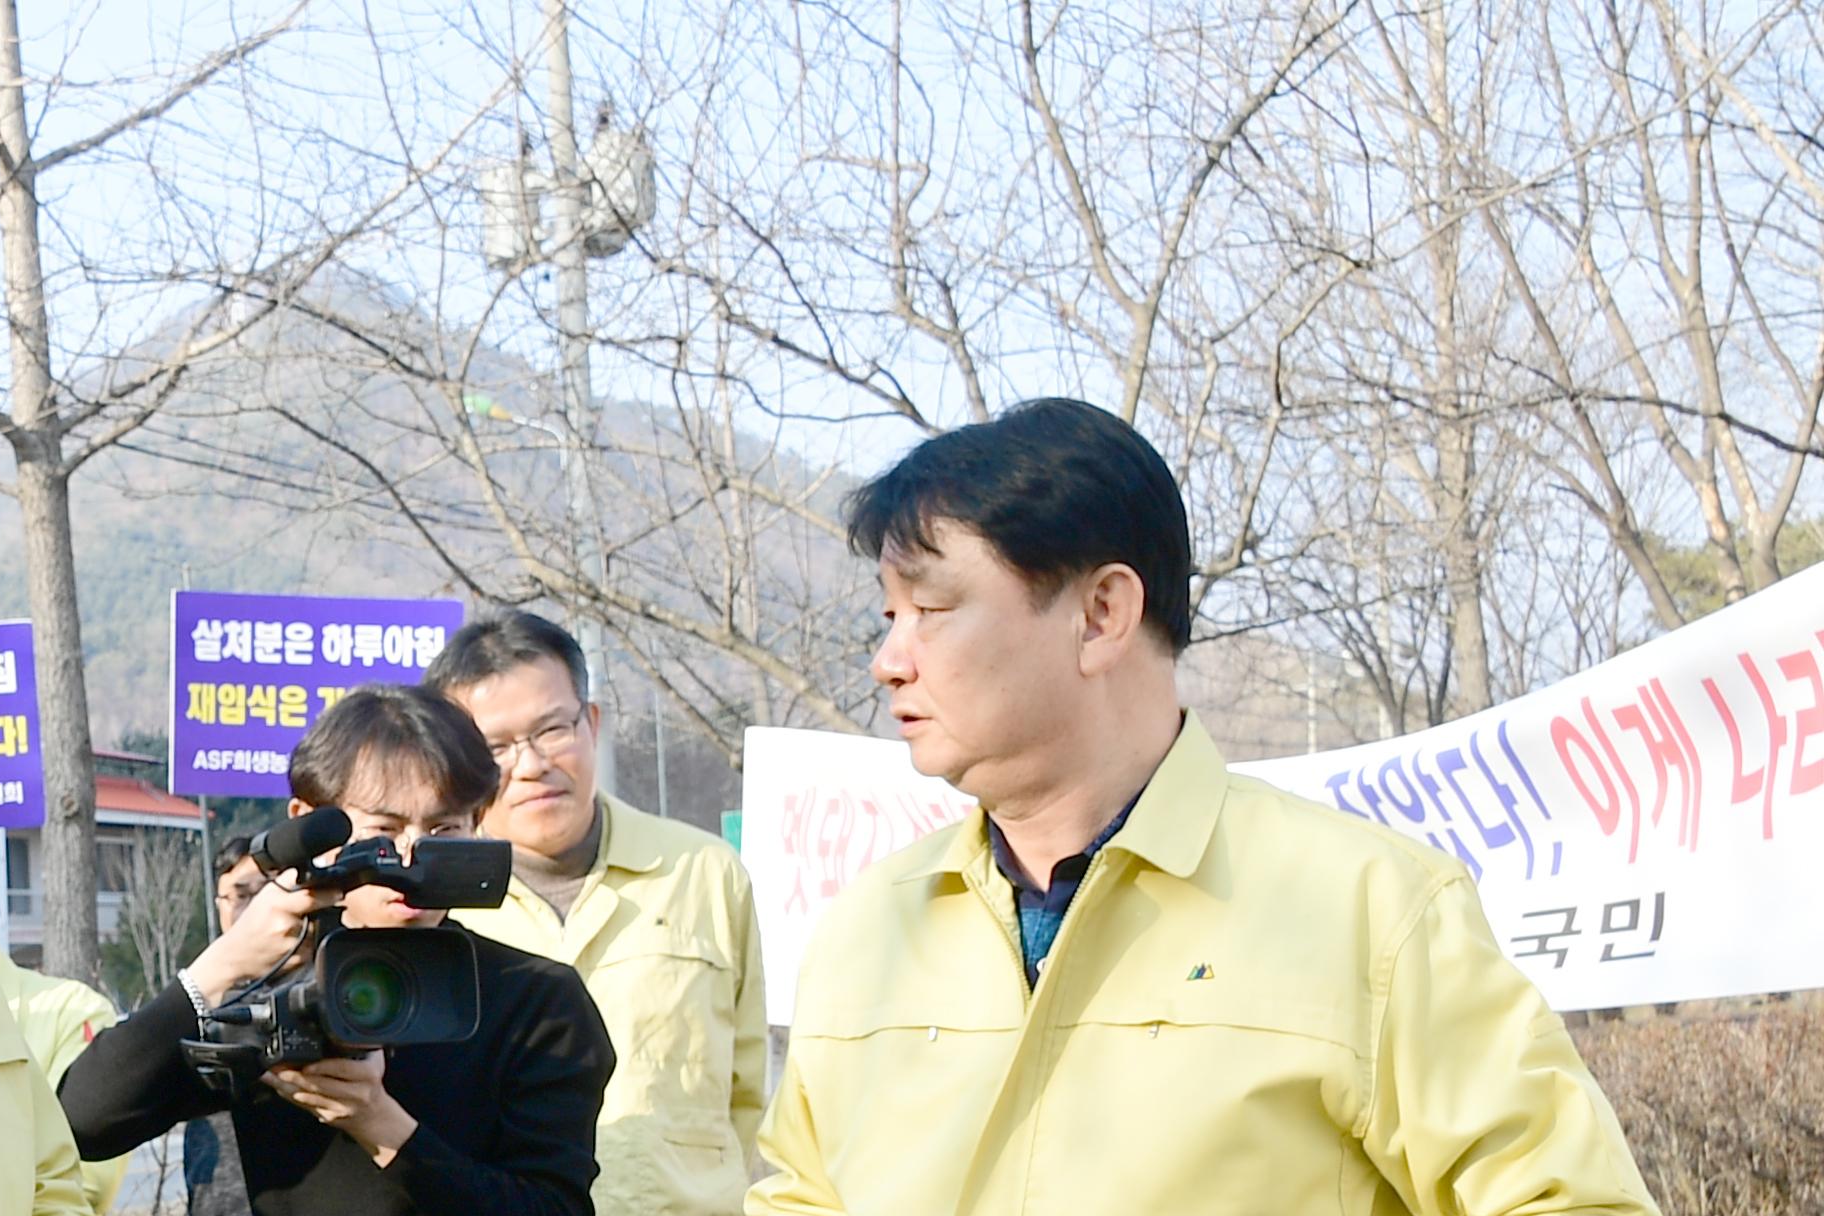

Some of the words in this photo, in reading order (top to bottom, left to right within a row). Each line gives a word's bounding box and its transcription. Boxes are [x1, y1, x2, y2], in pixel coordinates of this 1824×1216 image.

[191, 619, 314, 665] 살처분은
[321, 623, 445, 668] 하루아침
[185, 682, 308, 727] 재입식은
[1549, 676, 1703, 866] 이게
